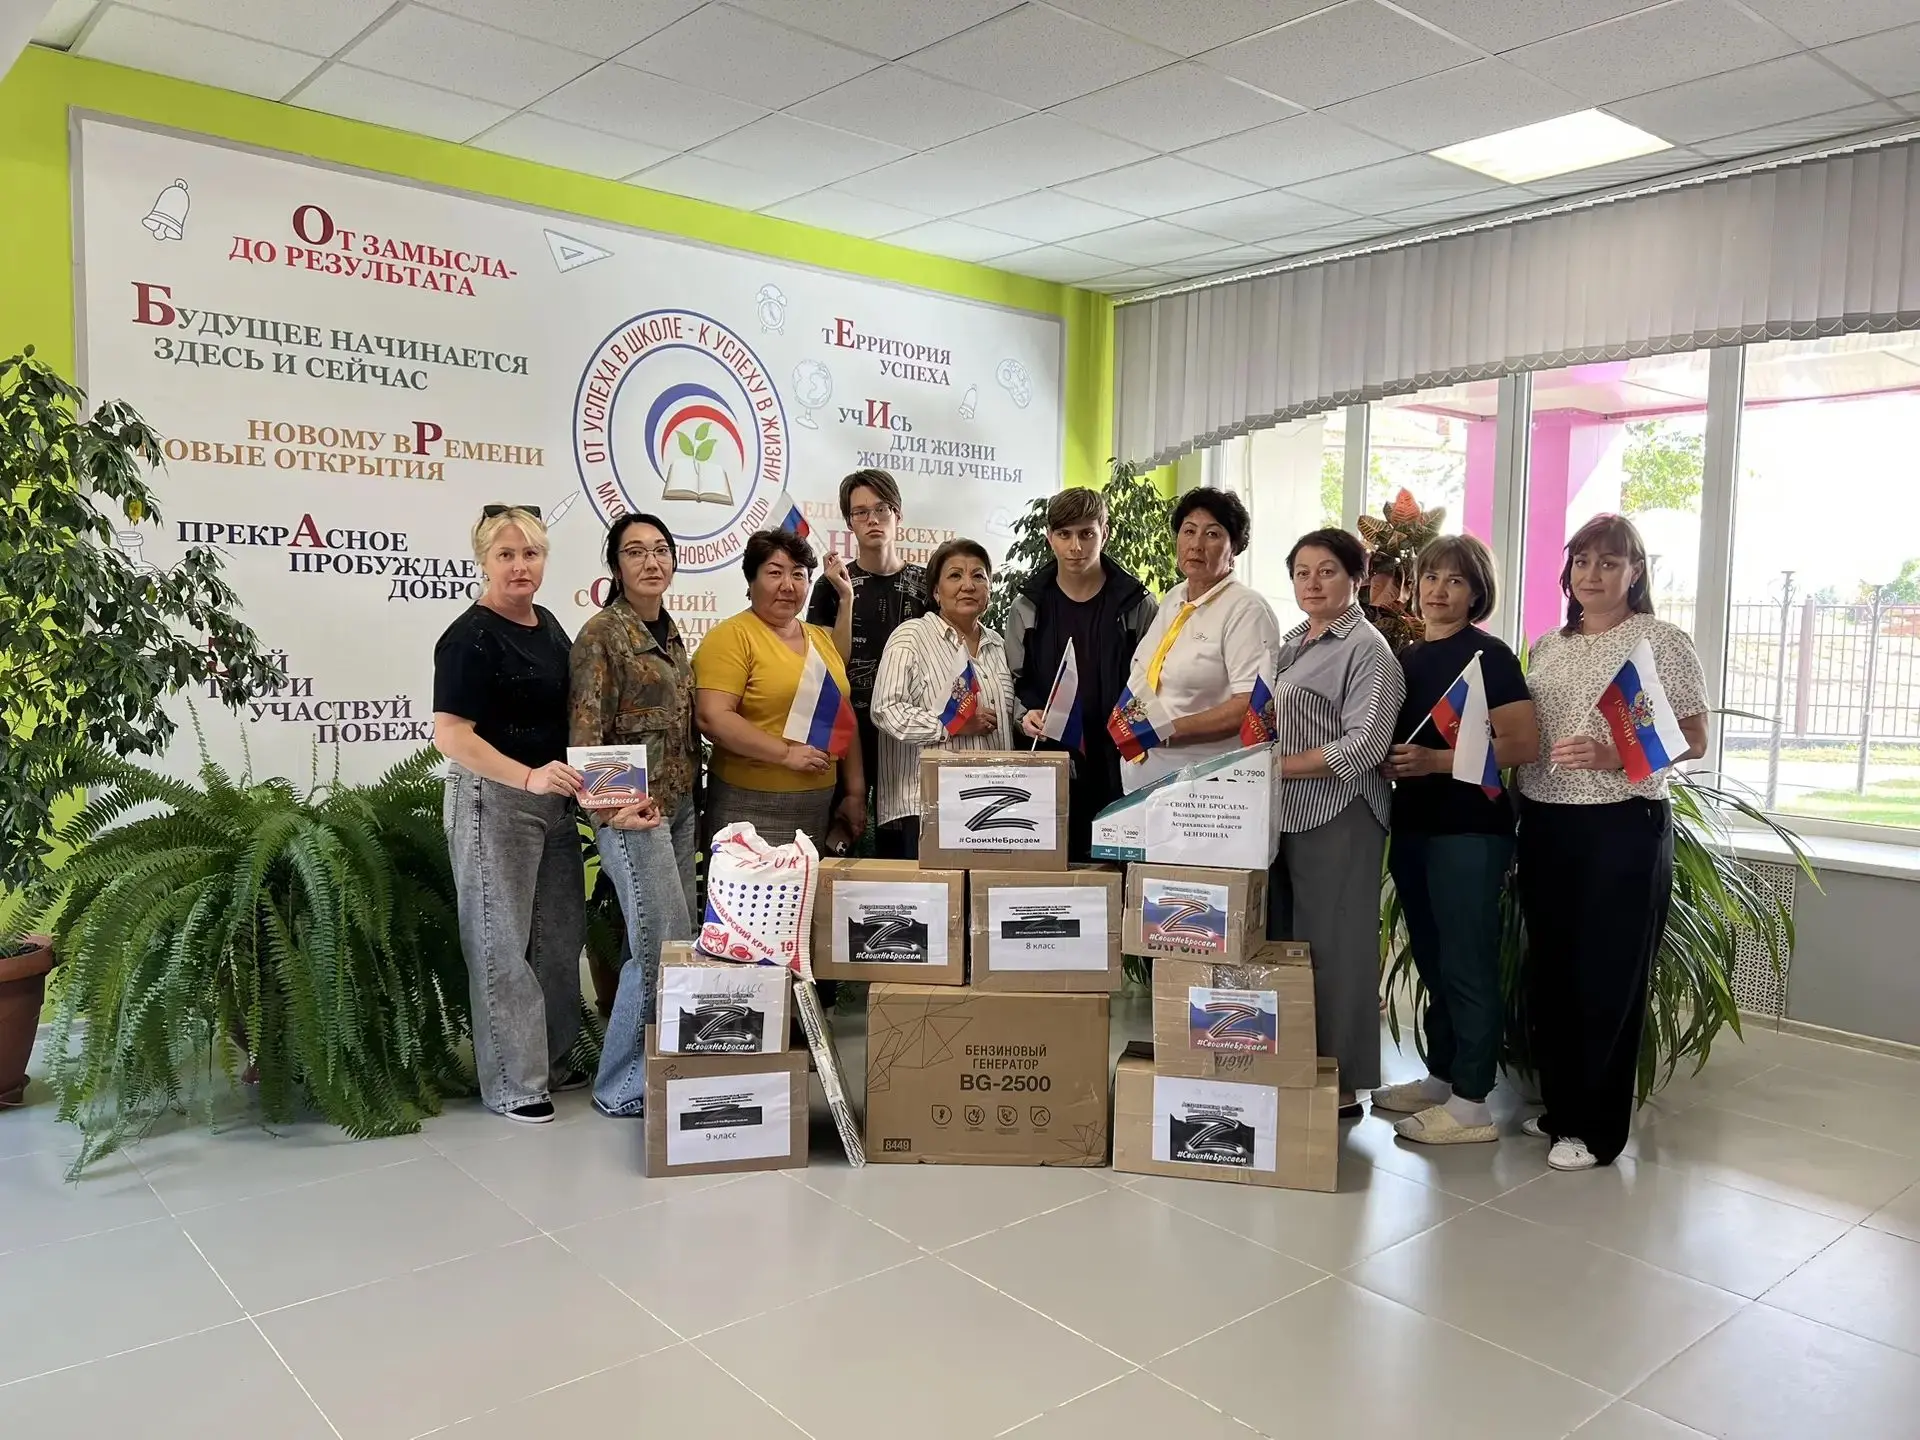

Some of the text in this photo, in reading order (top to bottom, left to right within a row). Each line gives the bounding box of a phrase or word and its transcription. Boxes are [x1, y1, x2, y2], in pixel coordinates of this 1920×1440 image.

[293, 204, 518, 281] ОТ ЗАМЫСЛА-
[229, 235, 476, 297] ДО РЕЗУЛЬТАТА
[132, 280, 529, 376] БУДУЩЕЕ НАЧИНАЕТСЯ
[622, 317, 683, 355] ШКОЛЕ
[698, 323, 711, 345] К
[822, 317, 951, 366] ТЕРРИТОРИЯ
[154, 337, 428, 391] ЗДЕСЬ И СЕЙЧАС
[610, 343, 629, 364] В
[713, 331, 767, 393] УСПЕХУ
[879, 359, 951, 386] УСПЕХА
[585, 358, 619, 433] УСПЕХА
[756, 396, 774, 412] В
[838, 399, 913, 432] УЧИСЬ
[247, 419, 544, 468] НОВОМУ ВРЕМЕНИ
[584, 439, 605, 464] ОТ
[760, 416, 782, 483] ЖИЗНИ
[890, 434, 996, 461] ДЛЯ ЖИЗНИ
[137, 438, 445, 481] ОВЫЕ ОТКРЫТИЯ
[857, 450, 1023, 484] ЖИВИ ДЛЯ УЧЕНЬЯ
[176, 513, 409, 552] ПРЕКРАСНОЕ
[675, 532, 741, 565] НОВСКАЯ
[288, 553, 486, 581] ПРОБУЖДАЕ
[204, 677, 314, 699] ТОРИ
[250, 695, 412, 722] УЧАСТВУЙ
[317, 721, 435, 743] ПОБЕЖ
[1233, 768, 1266, 778] DL-7900
[959, 836, 1041, 845] #СвоихНеБросаем
[751, 937, 775, 957] КРАЙ
[780, 941, 794, 953] 10
[856, 951, 921, 961] #СвоихНеБросаем
[685, 1042, 756, 1051] #СвоихНеБросаем
[965, 1043, 1047, 1057] БЕНЗИНОВЫЙ
[973, 1058, 1039, 1070] ГЕНЕРАТОР
[960, 1074, 1051, 1092] BG-2500
[706, 1132, 737, 1141] 9 класс
[1177, 1149, 1247, 1165] #СвоихНеБросаем
